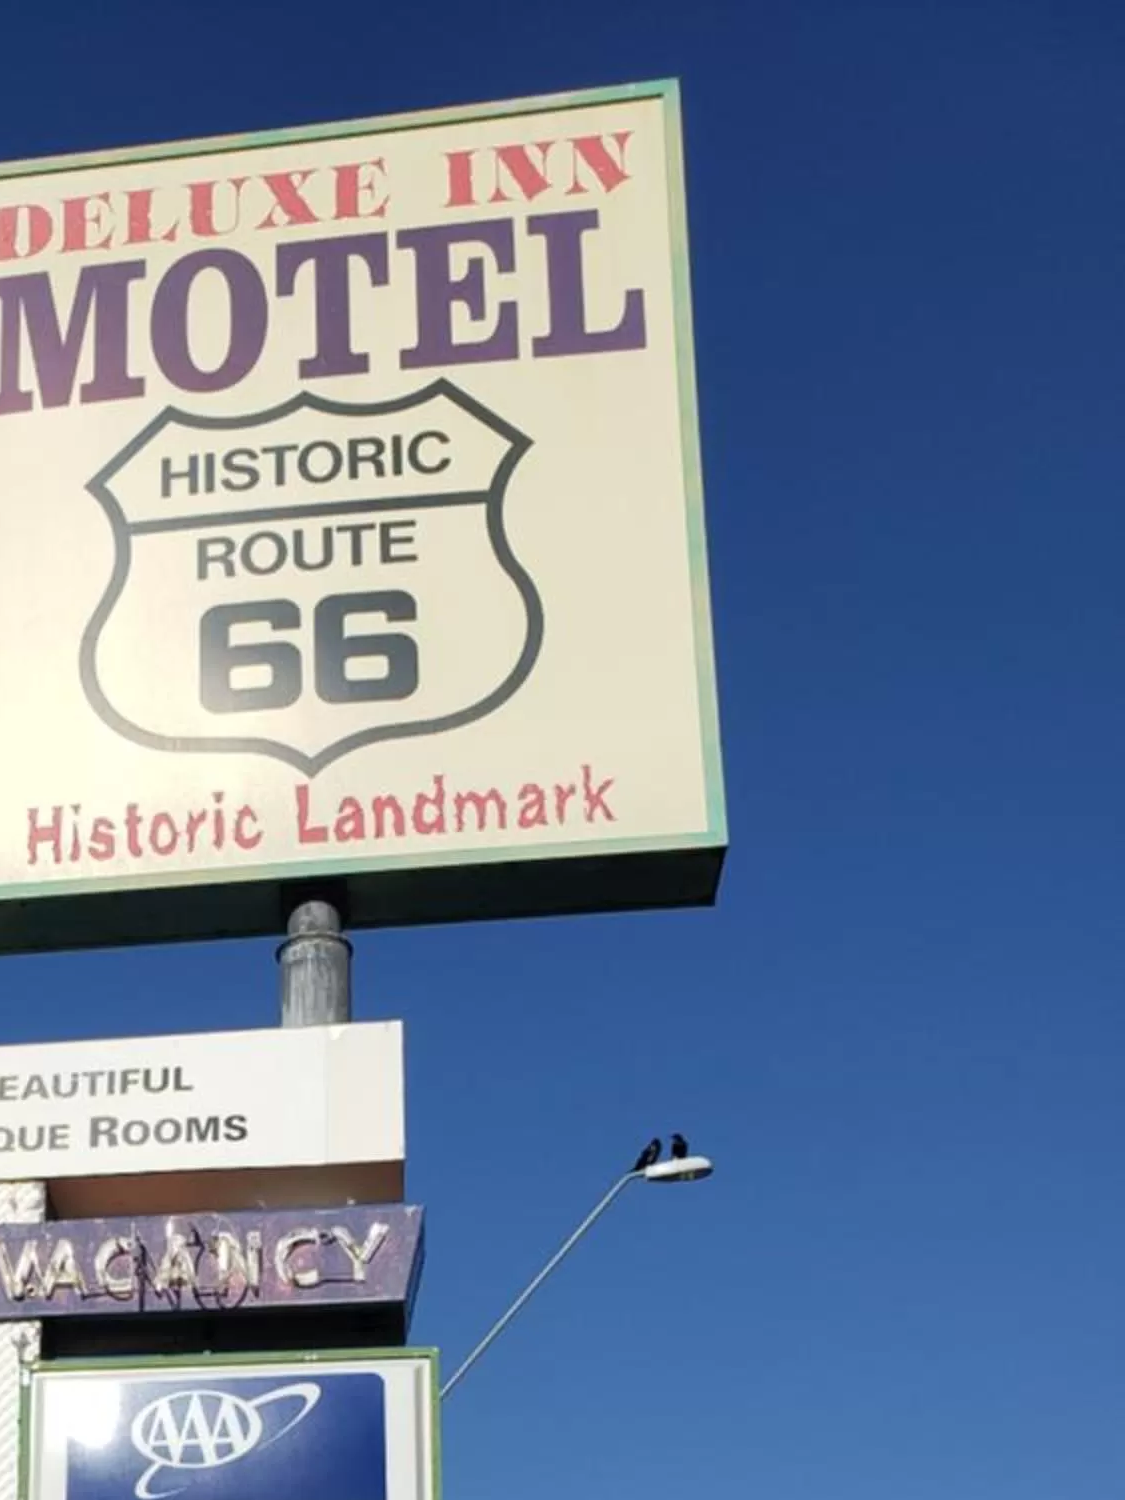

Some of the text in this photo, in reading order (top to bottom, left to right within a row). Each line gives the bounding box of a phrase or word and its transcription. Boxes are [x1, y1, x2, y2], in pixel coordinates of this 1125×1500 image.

[443, 130, 634, 211] INN
[160, 430, 453, 498] HISTORIC
[195, 519, 419, 581] ROUTE
[198, 588, 420, 716] 66
[26, 764, 620, 866] Historic Landmark
[88, 1113, 249, 1150] ROOMS
[146, 1391, 246, 1467] AAA
